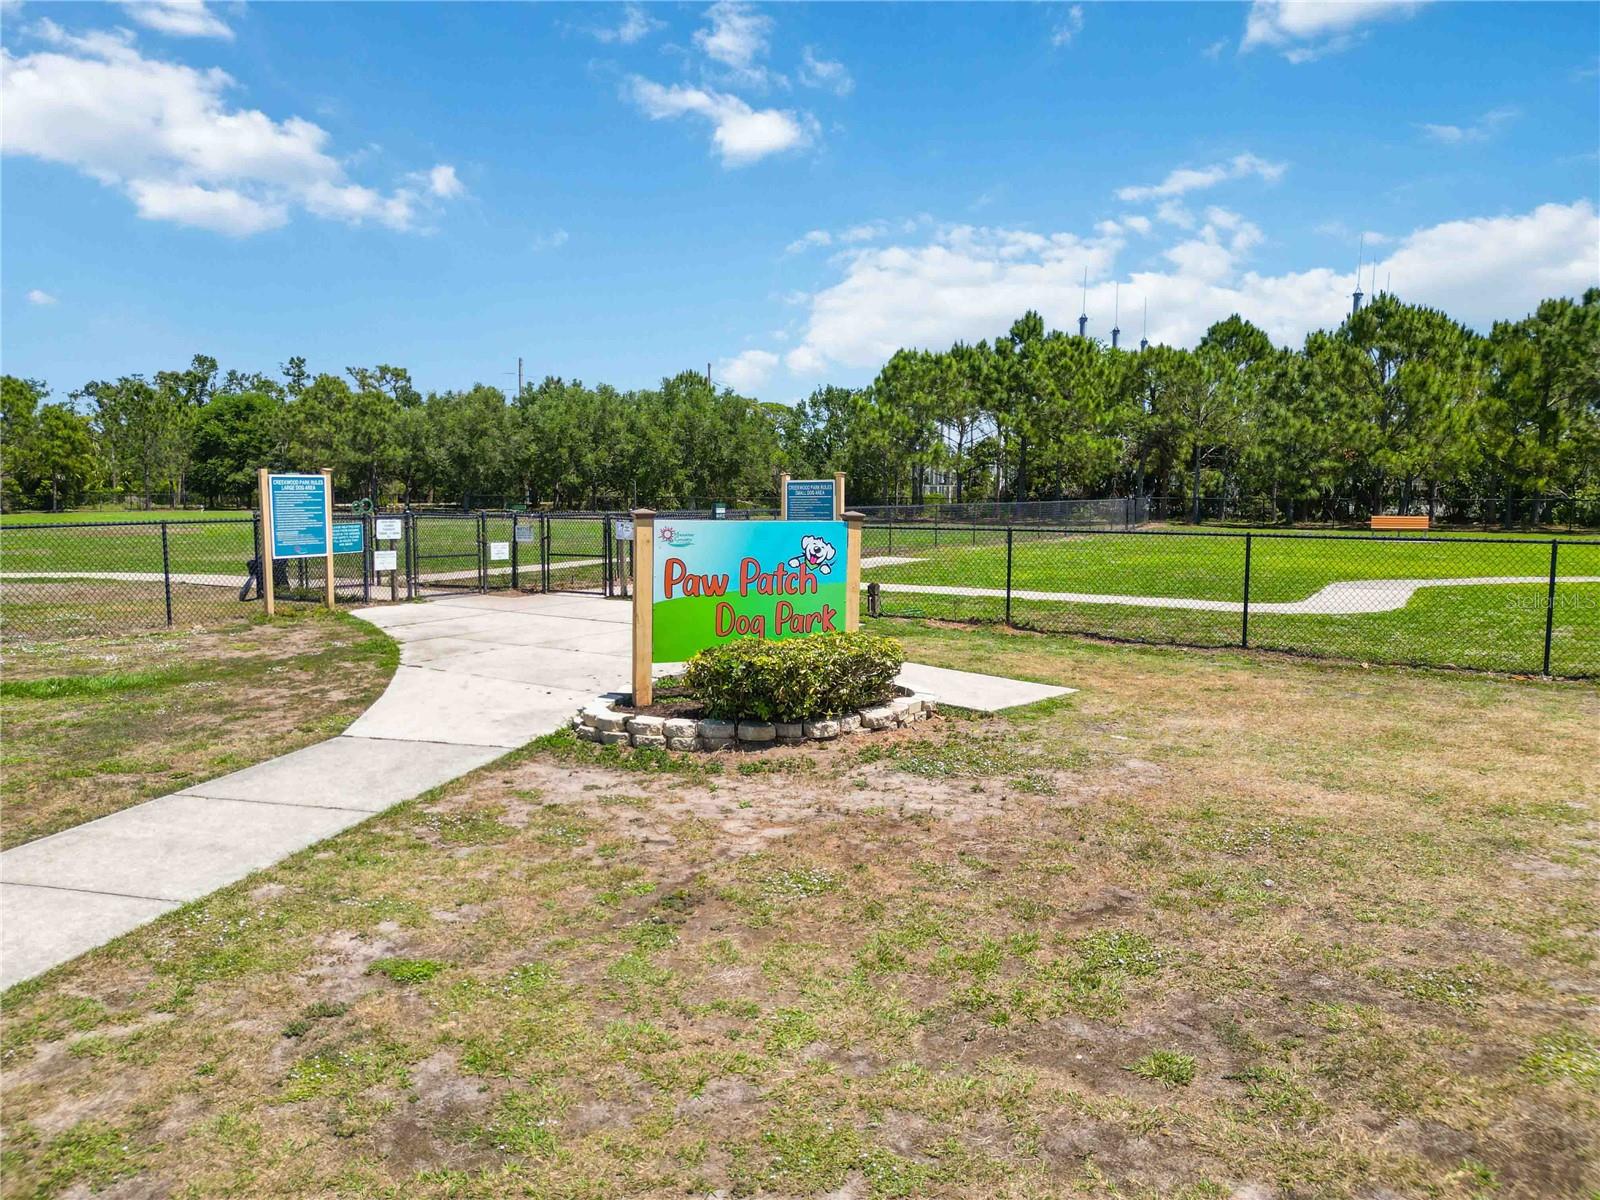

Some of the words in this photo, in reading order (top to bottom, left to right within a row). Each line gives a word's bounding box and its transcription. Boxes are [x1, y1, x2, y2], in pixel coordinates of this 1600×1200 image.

[664, 558, 729, 599] Paw
[740, 557, 818, 597] Patch
[715, 602, 765, 638] Dog
[775, 601, 836, 635] Park
